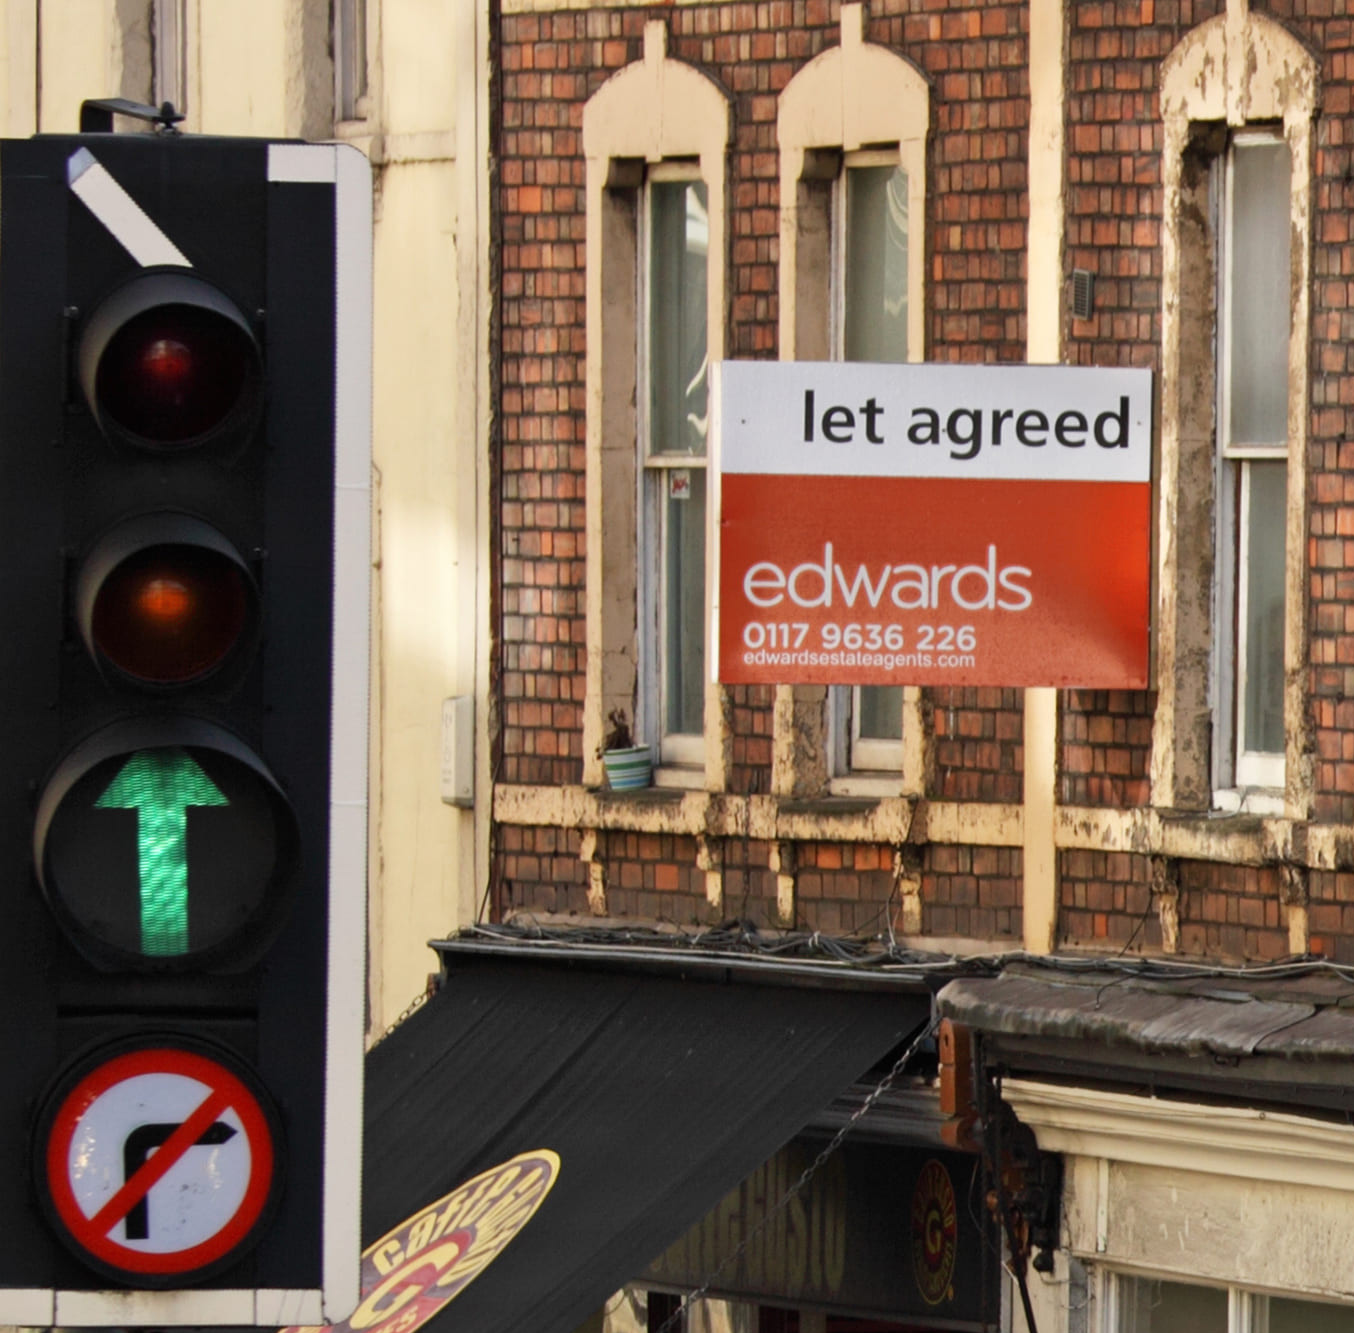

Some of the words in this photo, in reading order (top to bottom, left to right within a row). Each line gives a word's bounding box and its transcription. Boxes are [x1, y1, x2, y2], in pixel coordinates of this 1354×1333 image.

[803, 389, 884, 443] let
[907, 396, 1130, 460] agreed
[743, 542, 1032, 611] edwards
[743, 622, 809, 649] 0117
[821, 624, 903, 651] 9636
[917, 626, 976, 651] 226
[743, 649, 976, 669] edwardsestateagents.com
